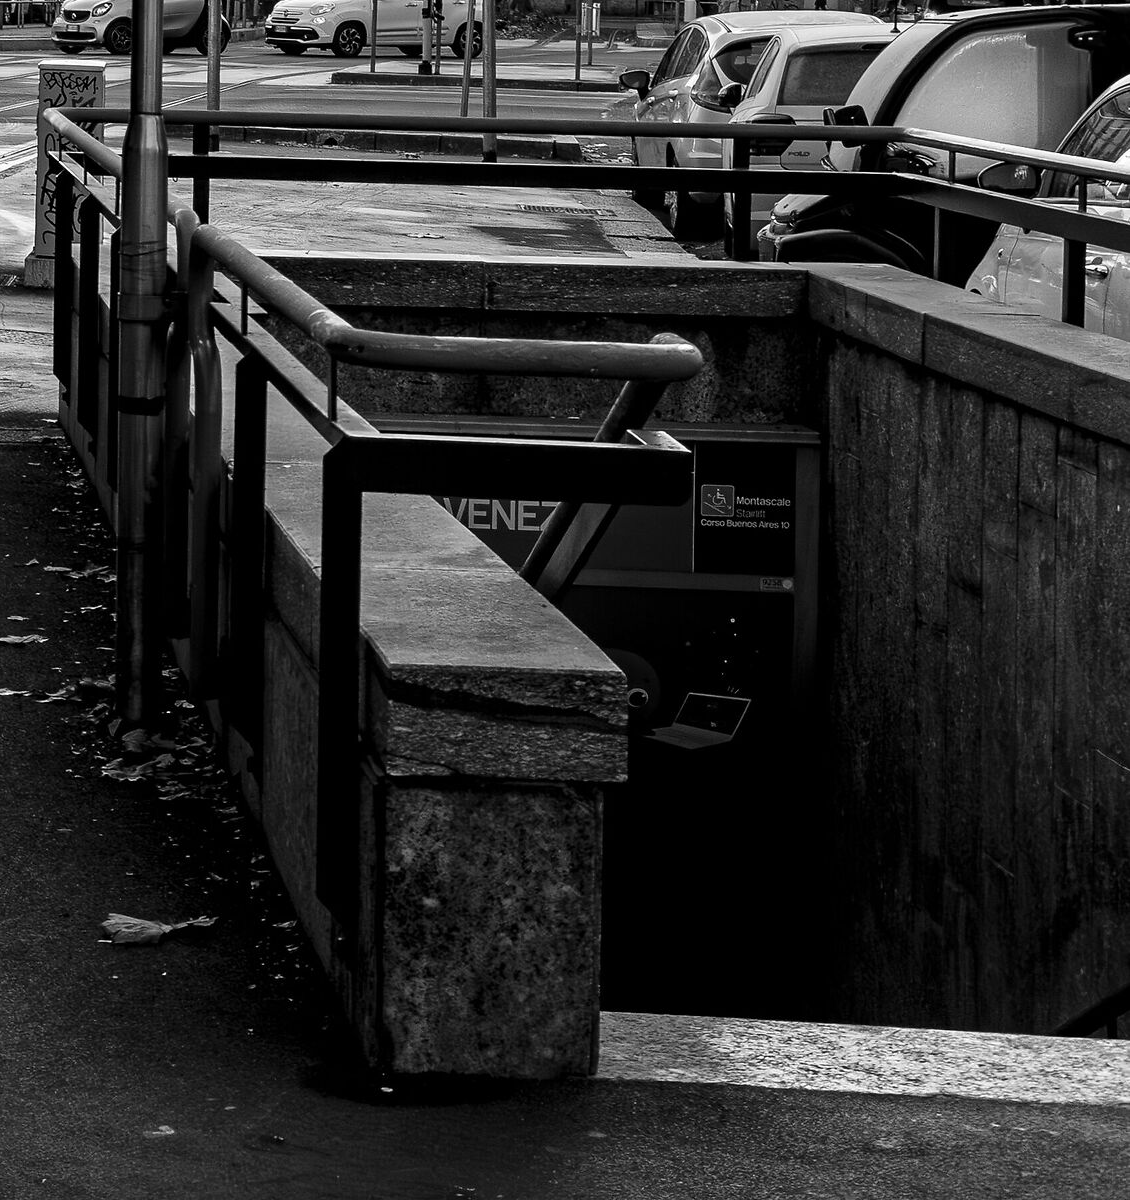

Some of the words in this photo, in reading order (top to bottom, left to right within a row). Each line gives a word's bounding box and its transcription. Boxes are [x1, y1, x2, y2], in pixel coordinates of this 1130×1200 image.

[736, 496, 791, 506] Montascale
[736, 509, 766, 518] Stairlift
[700, 519, 725, 527] Corso
[726, 519, 758, 528] Buenos
[759, 521, 780, 529] Aires
[781, 521, 790, 529] 10
